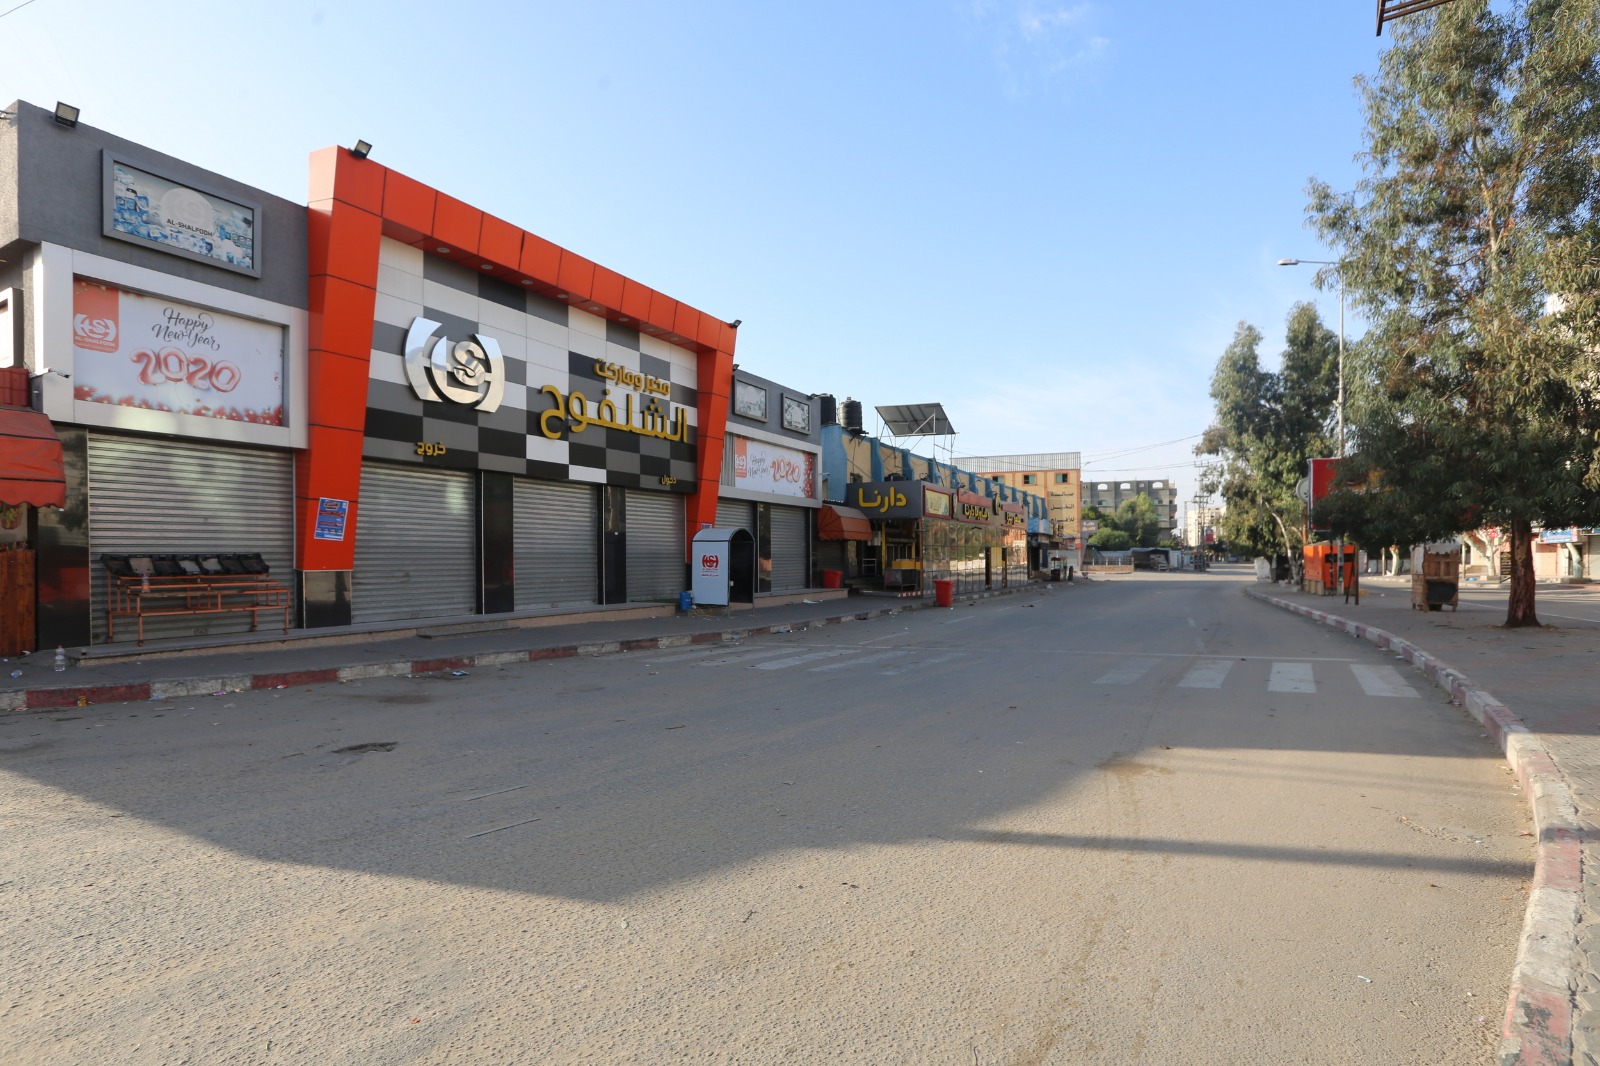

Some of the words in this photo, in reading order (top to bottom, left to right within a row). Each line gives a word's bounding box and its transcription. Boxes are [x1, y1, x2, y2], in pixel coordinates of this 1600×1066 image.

[162, 306, 214, 333] Happy
[151, 323, 187, 342] New
[185, 328, 220, 351] Year
[130, 346, 241, 392] 2020
[593, 357, 643, 391] وماركت
[642, 373, 671, 396] مخبز
[540, 384, 688, 443] الشلفوح
[416, 441, 446, 456] خروج
[661, 474, 677, 485] دخول
[770, 455, 801, 483] 2020
[858, 486, 907, 513] دارنا
